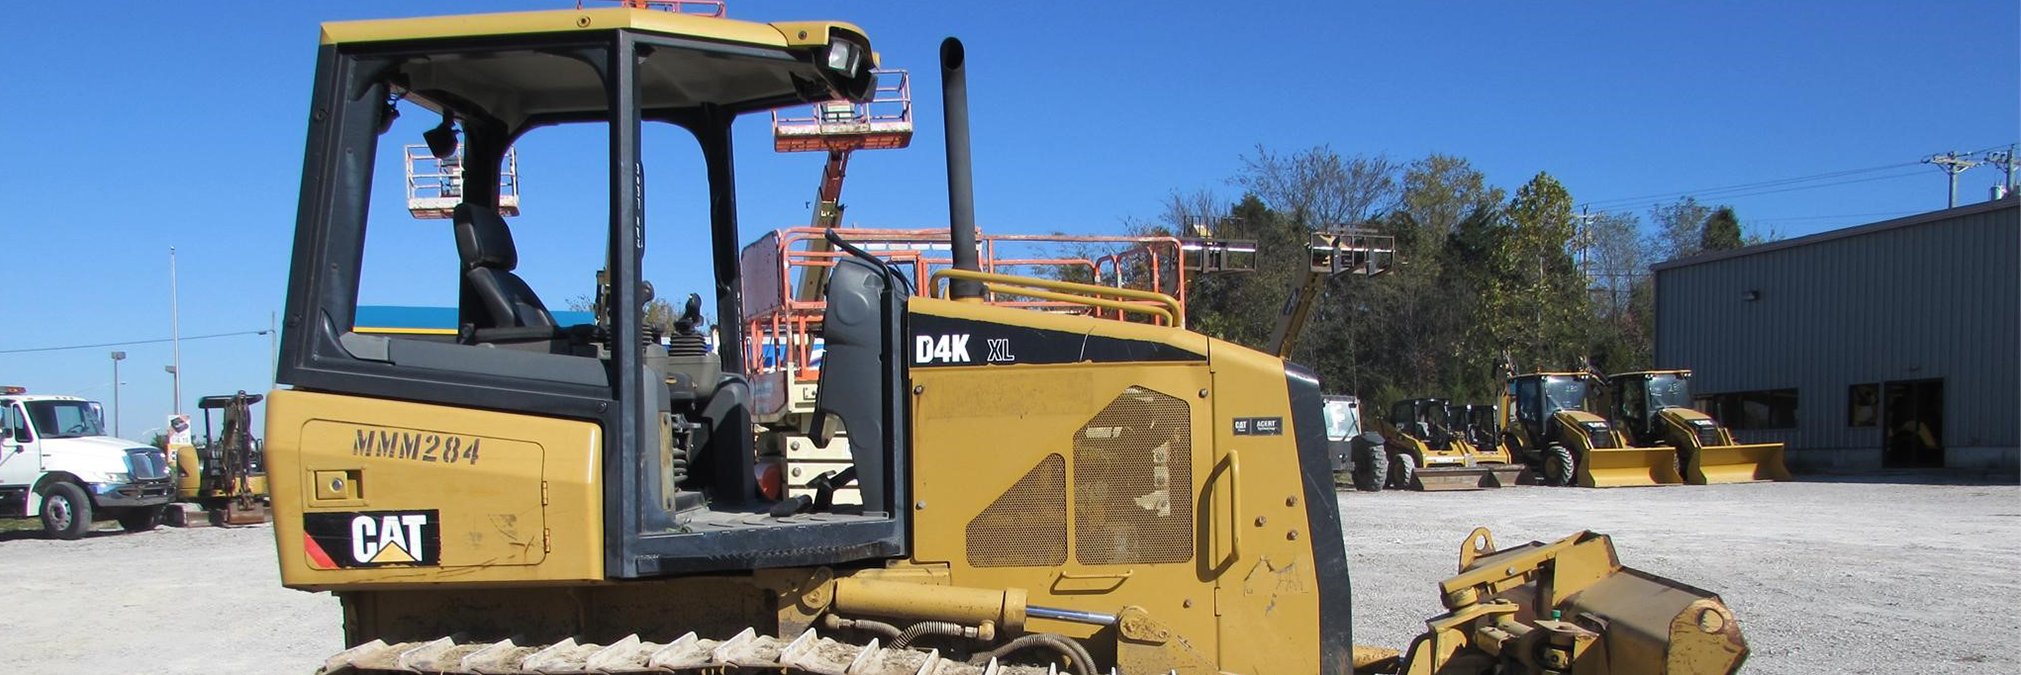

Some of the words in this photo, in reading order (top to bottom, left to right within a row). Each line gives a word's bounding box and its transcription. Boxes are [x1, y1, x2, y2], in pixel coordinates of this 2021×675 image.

[916, 334, 971, 363] D4K
[987, 338, 1015, 362] XL
[1235, 421, 1247, 429] CAT
[352, 429, 480, 465] MMM284
[352, 514, 427, 563] CAT
